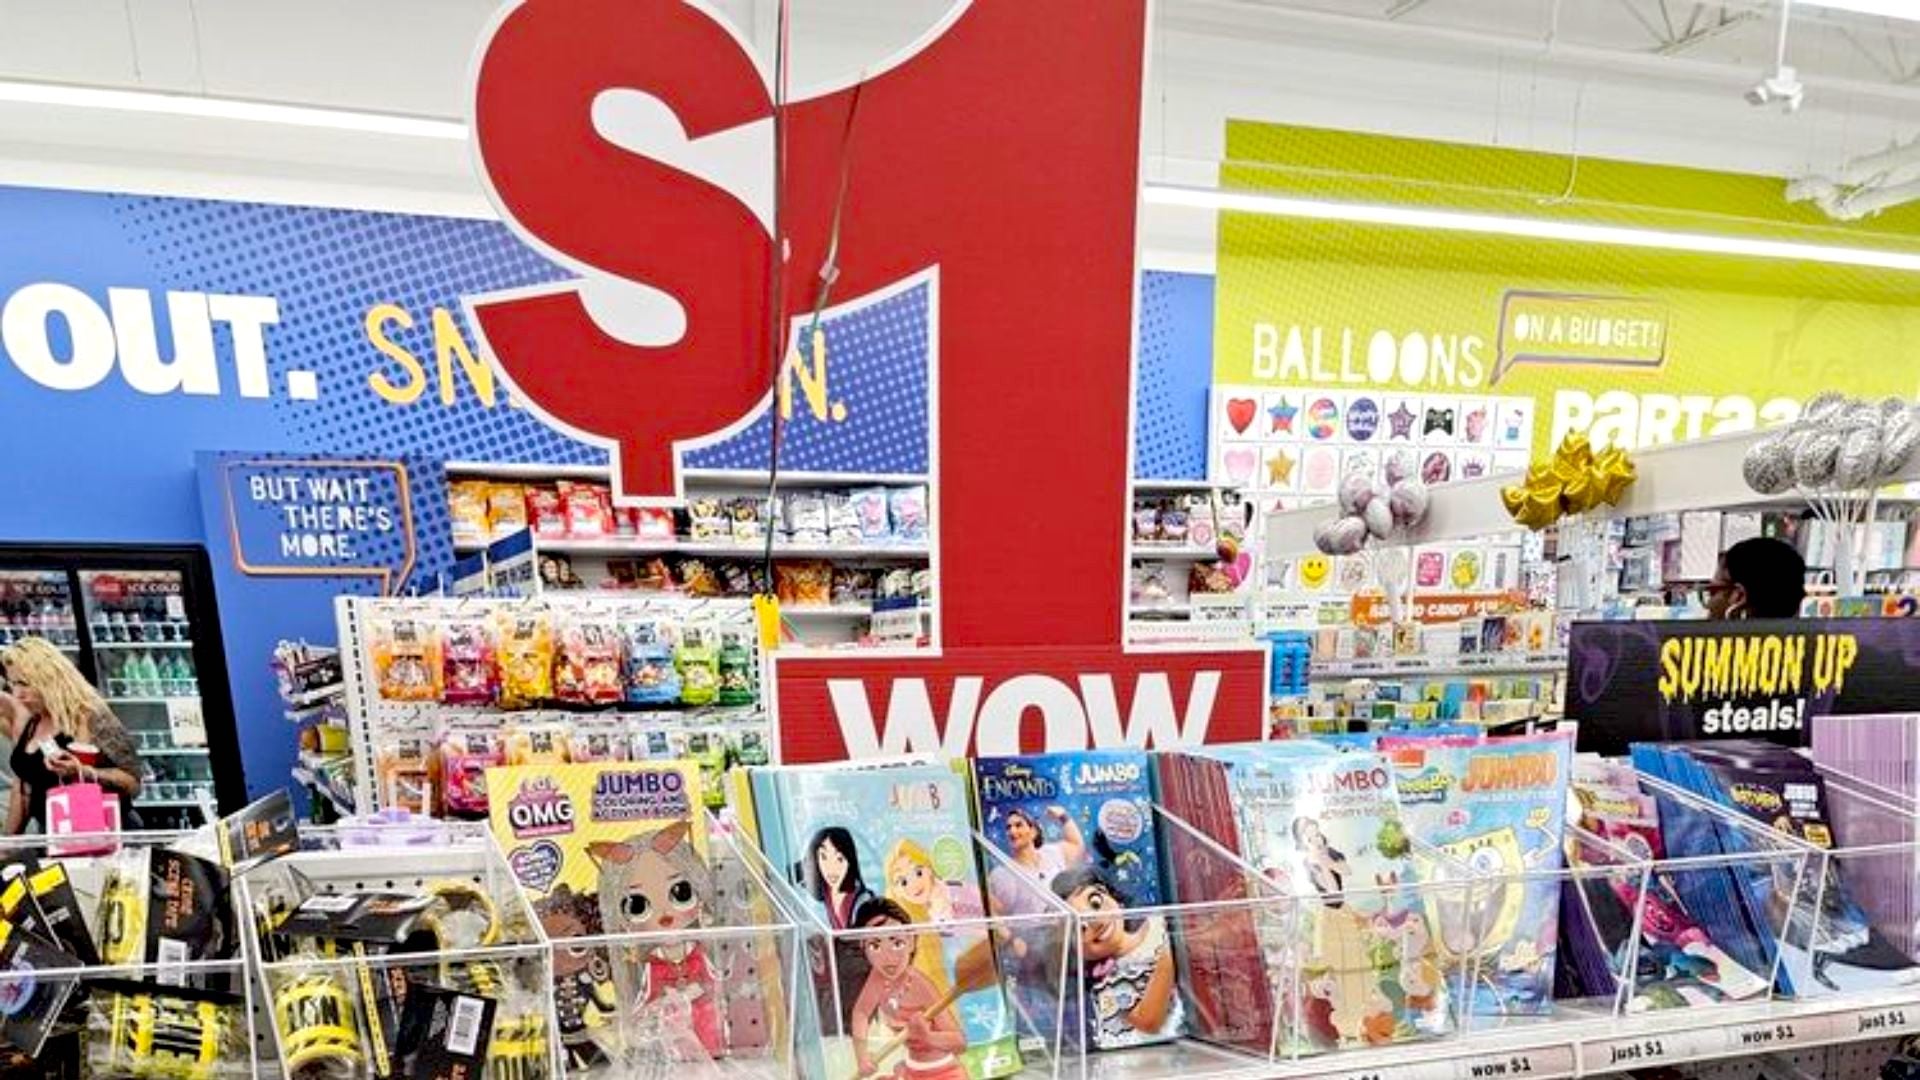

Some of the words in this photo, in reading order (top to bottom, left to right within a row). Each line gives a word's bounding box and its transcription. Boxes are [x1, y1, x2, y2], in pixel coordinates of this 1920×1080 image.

[2, 281, 318, 400] OUT.
[1514, 317, 1544, 342] ON
[1548, 317, 1563, 341] A
[1569, 317, 1658, 347] BUDGET!
[1252, 323, 1483, 388] BALLOONS
[250, 476, 302, 502] BUT
[308, 477, 370, 502] WAIT
[285, 505, 393, 531] THERE'S
[281, 532, 357, 559] MORE.
[1658, 634, 1804, 704] SUMMON
[1812, 634, 1858, 696] UP
[826, 670, 1221, 767] WOW
[1702, 697, 1805, 733] steals!
[596, 772, 682, 795] JUMBO
[1077, 762, 1141, 785] JUMBO
[1307, 767, 1389, 793] JUMBO
[983, 776, 1056, 800] ENCANTO
[511, 800, 574, 827] OMG
[1741, 1029, 1772, 1043] wow
[1776, 1024, 1795, 1040] $1
[1857, 1014, 1886, 1033] just
[1889, 1011, 1906, 1025] $1
[1610, 1045, 1643, 1064] just
[1645, 1041, 1664, 1057] $1
[1471, 1062, 1506, 1077] wow
[1510, 1057, 1532, 1073] $1
